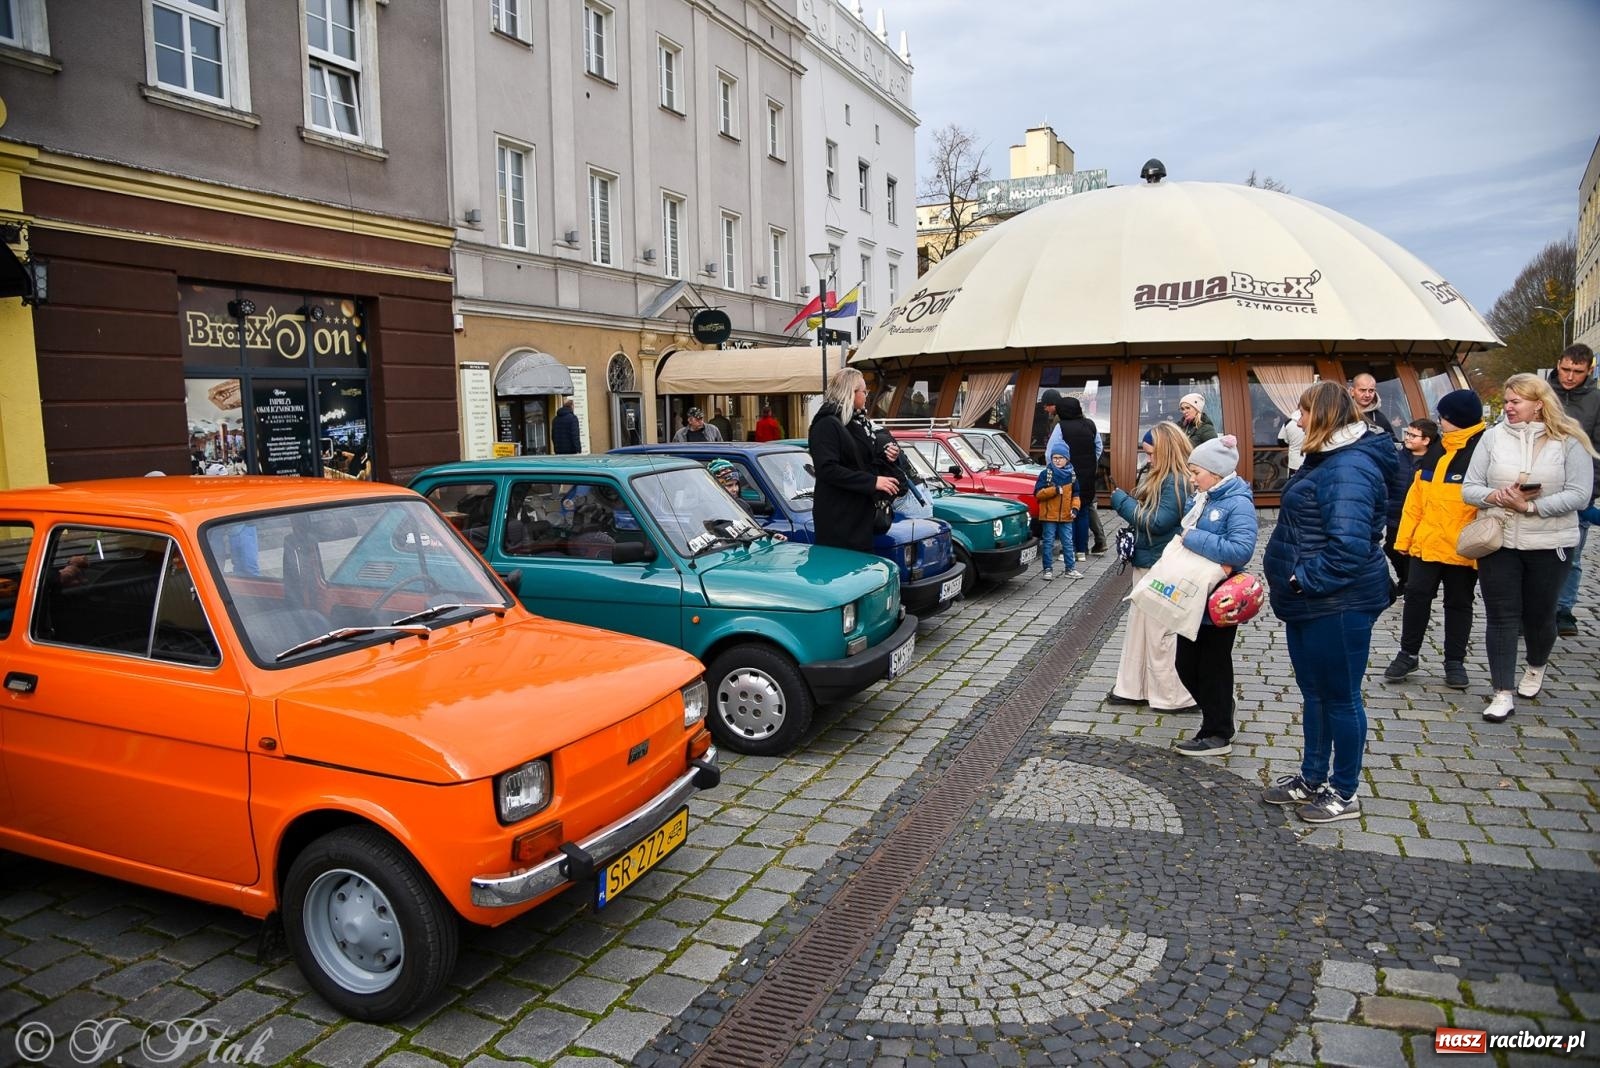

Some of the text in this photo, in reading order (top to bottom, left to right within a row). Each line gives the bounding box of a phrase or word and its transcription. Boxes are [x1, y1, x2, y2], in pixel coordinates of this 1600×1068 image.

[1009, 184, 1073, 200] McDonald's
[1134, 276, 1227, 310] aqua
[1236, 299, 1318, 314] SZYMOCICE
[610, 829, 665, 894] SR 272
